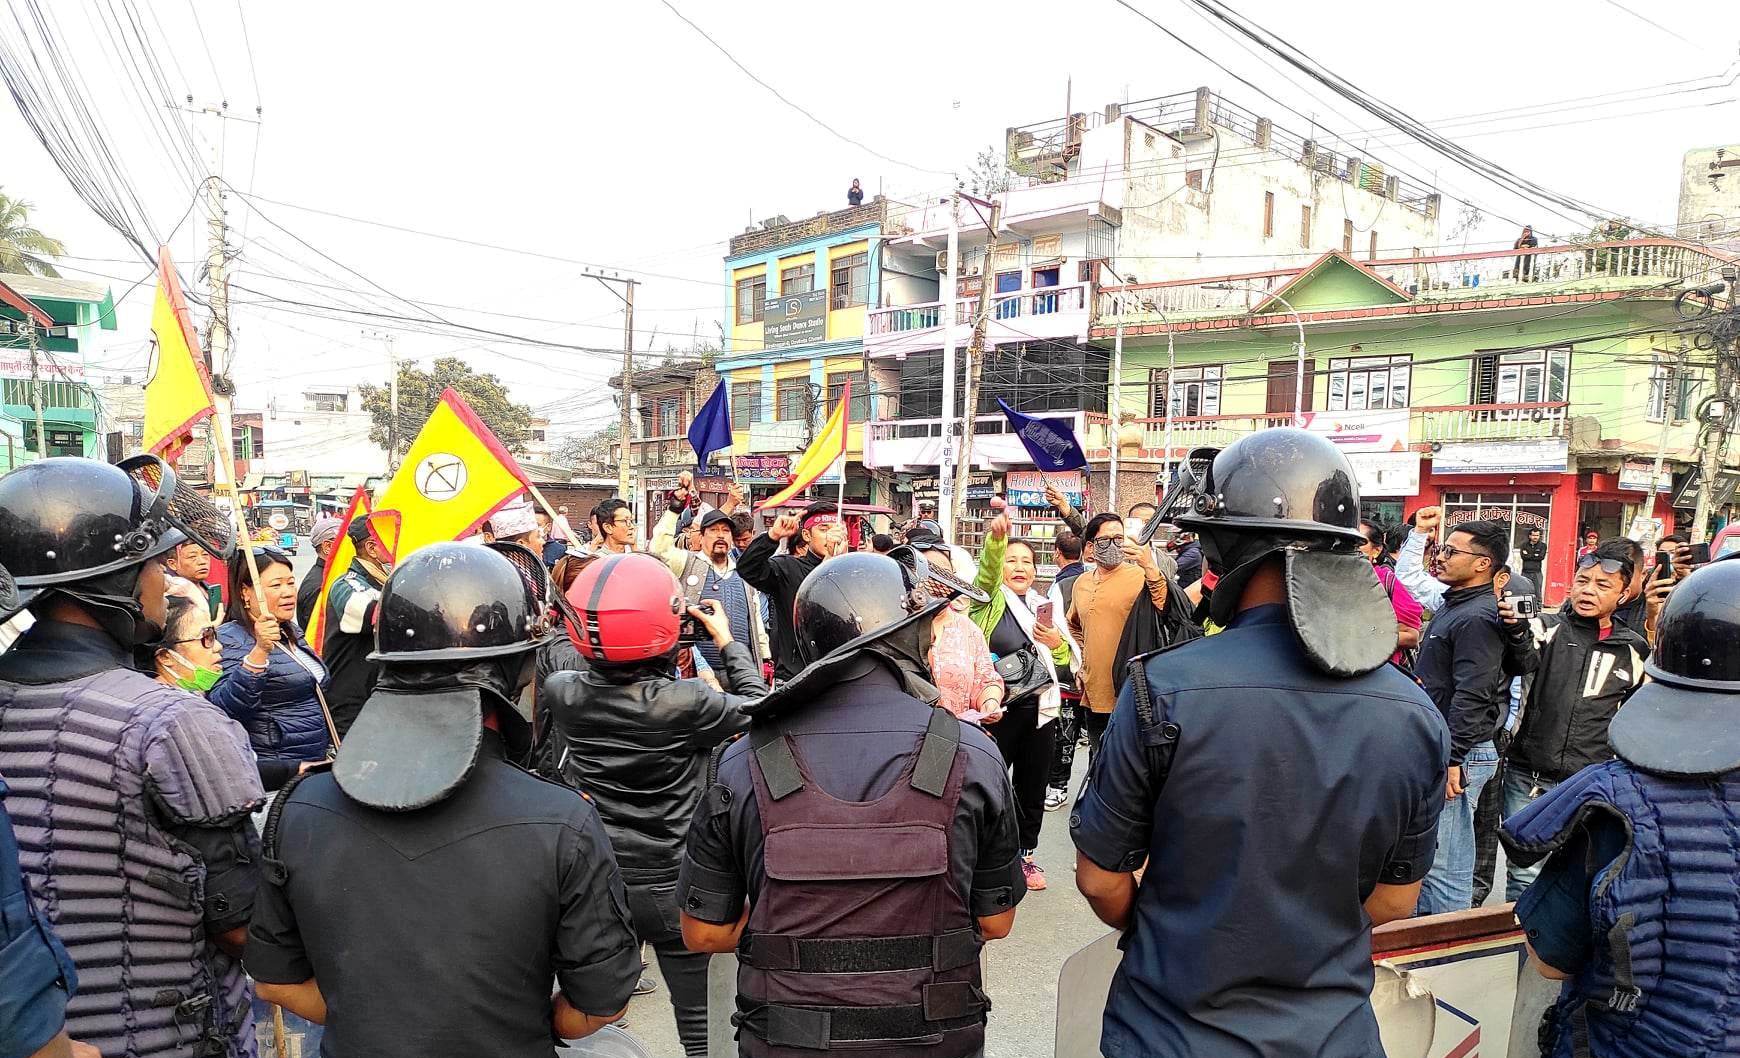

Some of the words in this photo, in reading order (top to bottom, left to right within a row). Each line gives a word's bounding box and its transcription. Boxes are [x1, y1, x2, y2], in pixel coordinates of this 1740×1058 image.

[1344, 423, 1365, 431] Ncell
[1010, 472, 1037, 487] Hotel
[1040, 472, 1078, 487] Blessed
[1516, 511, 1548, 529] हाउस
